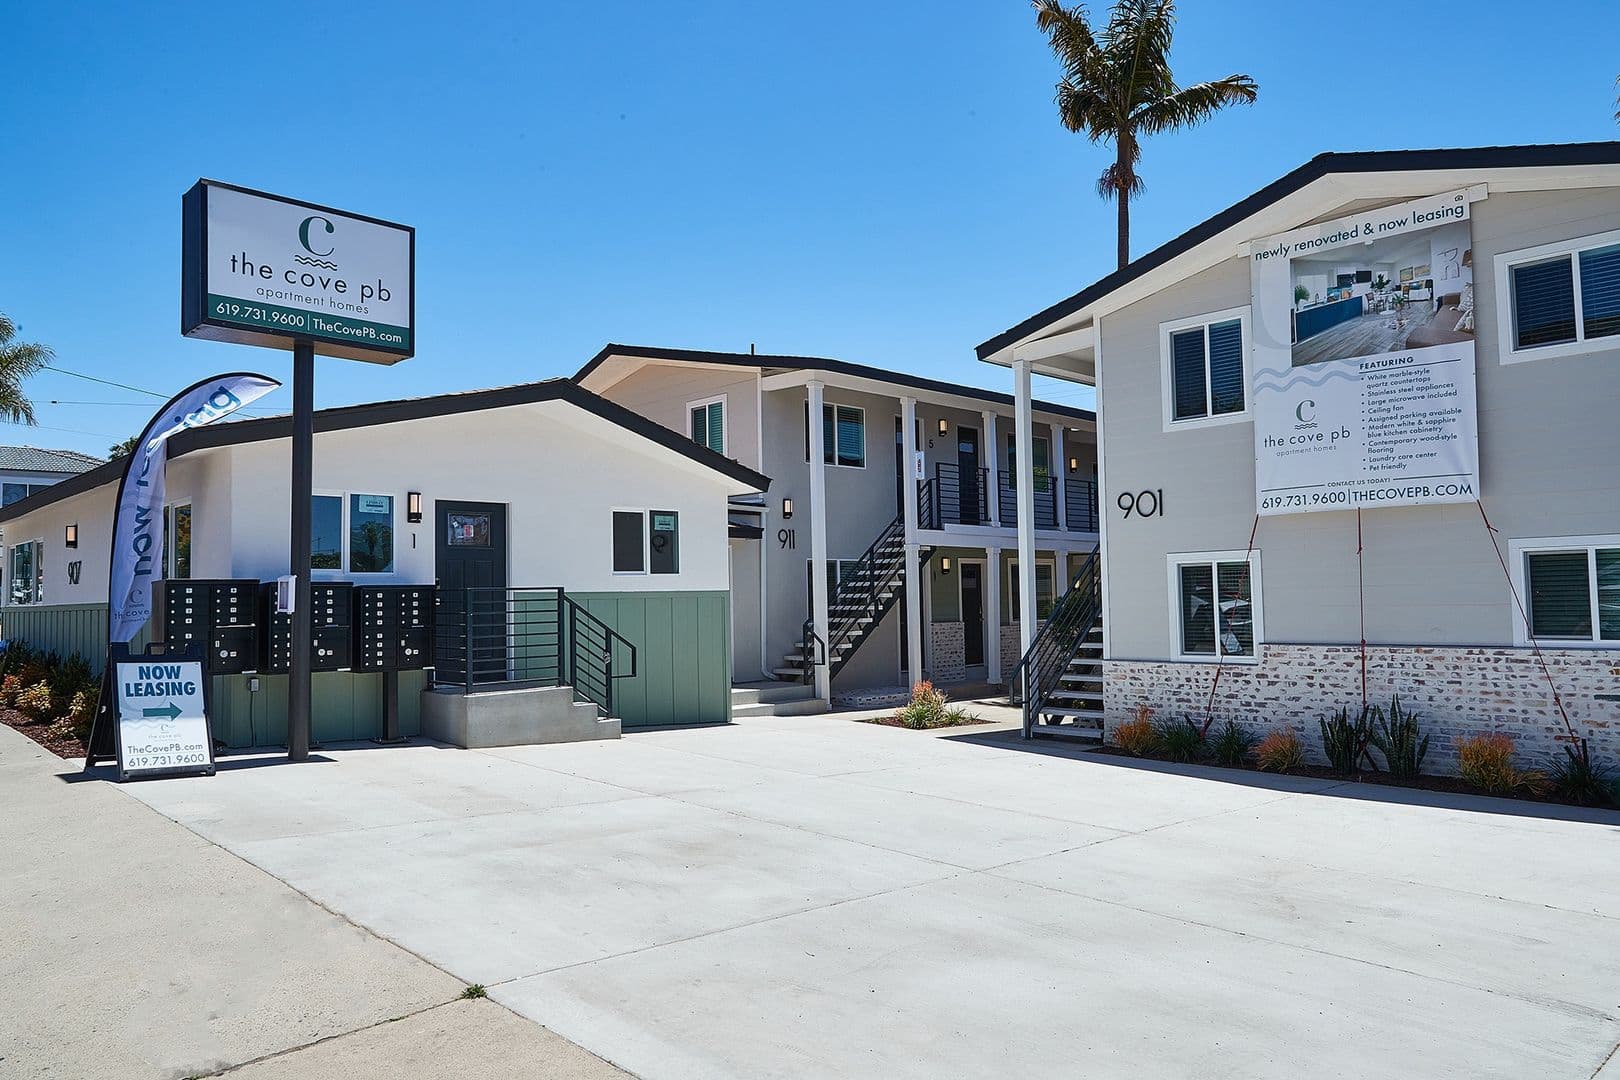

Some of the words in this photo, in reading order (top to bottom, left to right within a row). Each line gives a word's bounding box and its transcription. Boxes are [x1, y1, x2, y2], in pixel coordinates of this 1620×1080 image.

[1255, 242, 1291, 261] newly
[1294, 225, 1358, 252] renovated
[1363, 223, 1374, 235] &
[1378, 218, 1408, 232] now
[1412, 205, 1464, 224] leasing
[230, 252, 273, 280] the
[284, 269, 348, 294] cove
[360, 279, 390, 304] pb
[256, 288, 324, 306] apartment
[330, 296, 369, 314] homes
[216, 302, 304, 327] 619.731.9600
[312, 318, 402, 343] TheCovePB.com
[1360, 356, 1414, 370] FEATURING
[1367, 373, 1387, 381] White
[1389, 368, 1430, 378] marble-style
[1367, 381, 1388, 389] quartz
[1390, 376, 1431, 386] countertops
[1368, 389, 1396, 397] Stainless
[1416, 382, 1454, 392] appliances
[1368, 398, 1386, 406] Large
[1388, 394, 1426, 403] microwave
[1427, 390, 1458, 399] included
[1368, 406, 1391, 414] Ceiling
[1368, 414, 1398, 423] Assigned
[1400, 411, 1427, 420] parking
[1429, 408, 1462, 416] available
[1425, 417, 1456, 426] sapphire
[1264, 435, 1284, 448] the
[1290, 433, 1324, 444] cove
[1331, 426, 1350, 443] pb
[1384, 429, 1407, 437] kitchen
[1409, 425, 1443, 434] cabinetry
[928, 440, 934, 448] 5
[1368, 437, 1418, 446] Contemporary
[1420, 433, 1458, 442] wood-style
[1276, 447, 1312, 457] apartment
[1314, 444, 1336, 452] homes
[1368, 446, 1394, 454] flooring
[1369, 454, 1396, 463] Laundry
[1381, 463, 1407, 471] friendly
[1117, 488, 1163, 519] 901
[1262, 492, 1346, 509] 619.731.9600
[1352, 484, 1472, 501] THECOVEPB.COM
[132, 505, 152, 576] now
[777, 528, 796, 549] 911
[138, 666, 181, 680] NOW
[125, 682, 196, 697] LEASING
[128, 743, 203, 754] TheCovePB.com
[128, 754, 204, 767] 619.731.9600
